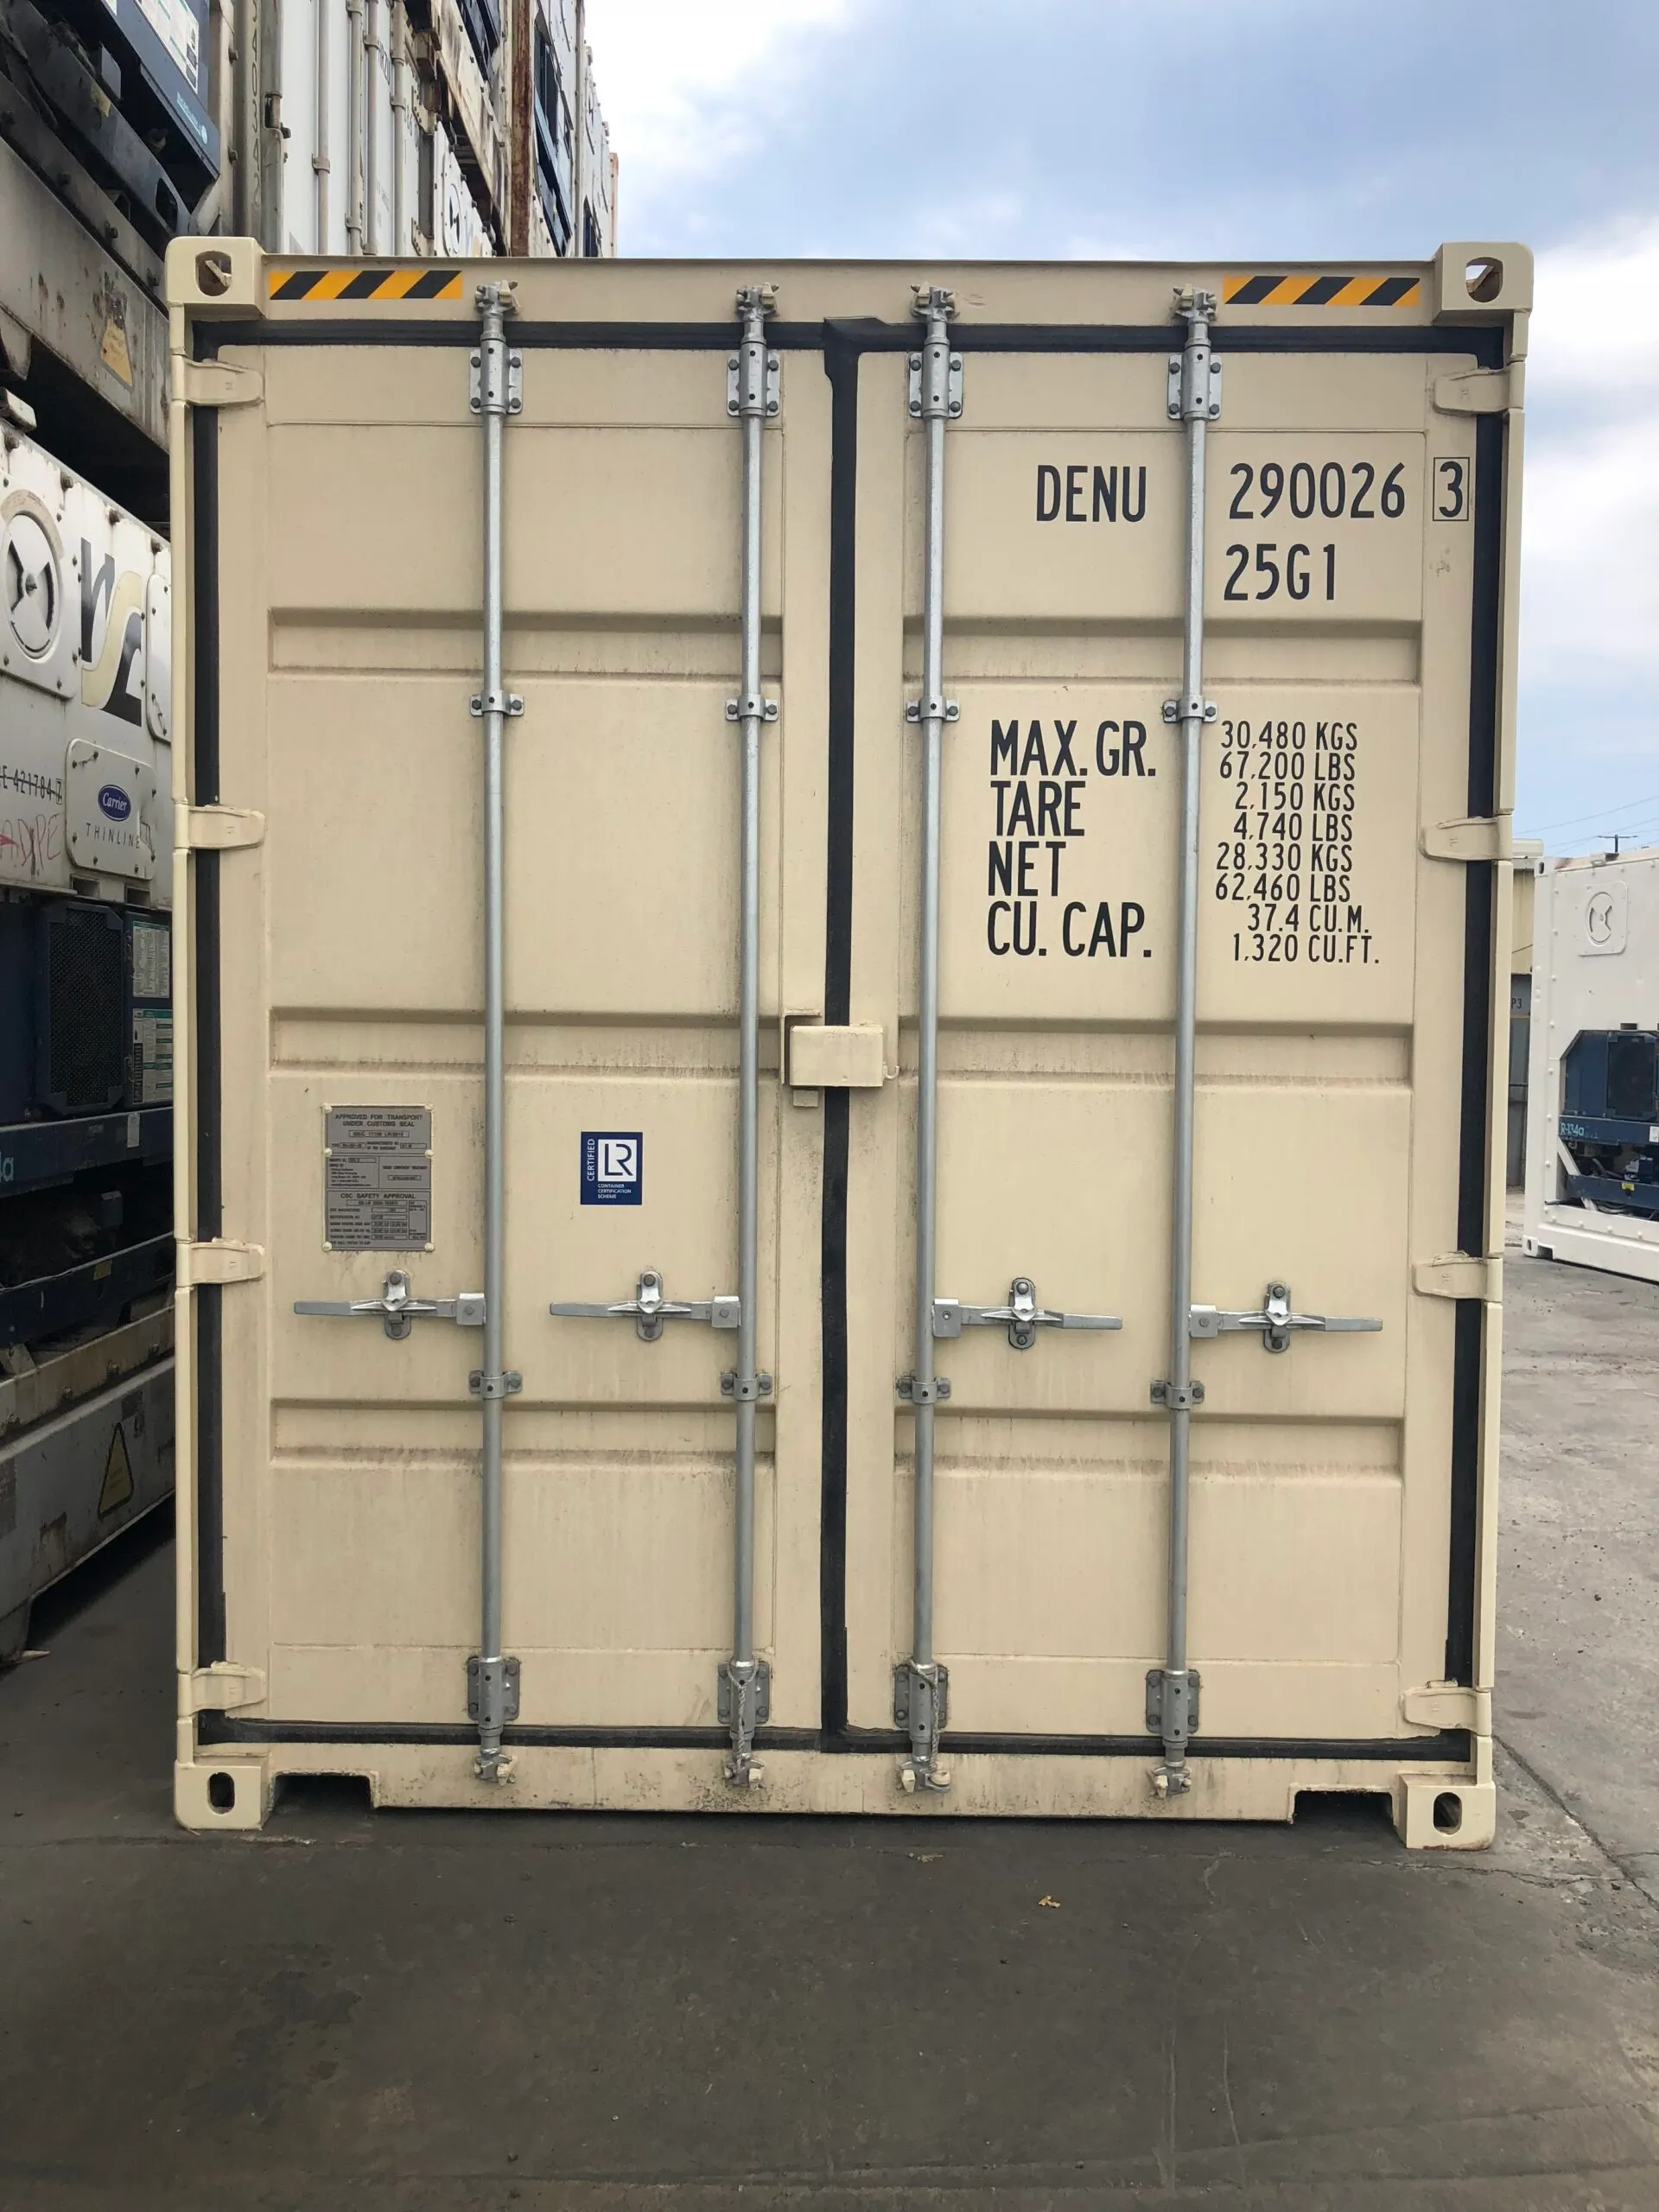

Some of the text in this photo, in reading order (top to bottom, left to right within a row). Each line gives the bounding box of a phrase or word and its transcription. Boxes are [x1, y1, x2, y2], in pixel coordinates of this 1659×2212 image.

[1037, 461, 1463, 522] DENU 290026 3
[1224, 544, 1334, 601] 25G1
[1222, 721, 1305, 749] 30,480
[1316, 722, 1357, 750] KGS
[1220, 751, 1355, 780] 67,200 LBS
[102, 792, 128, 811] Carrier
[991, 781, 1354, 836] TARE 2,150 KGS
[86, 822, 140, 849] THINLINE
[1234, 812, 1351, 842] 4,740 LBS
[988, 842, 1351, 896] NET 28,330 KGS
[1216, 873, 1350, 902] 62,460 LBS
[988, 901, 1046, 956] CU.
[1063, 902, 1151, 957] CAP.
[1248, 904, 1299, 931] 37.4
[1234, 933, 1297, 962] 1,320
[605, 1143, 633, 1176] LR
